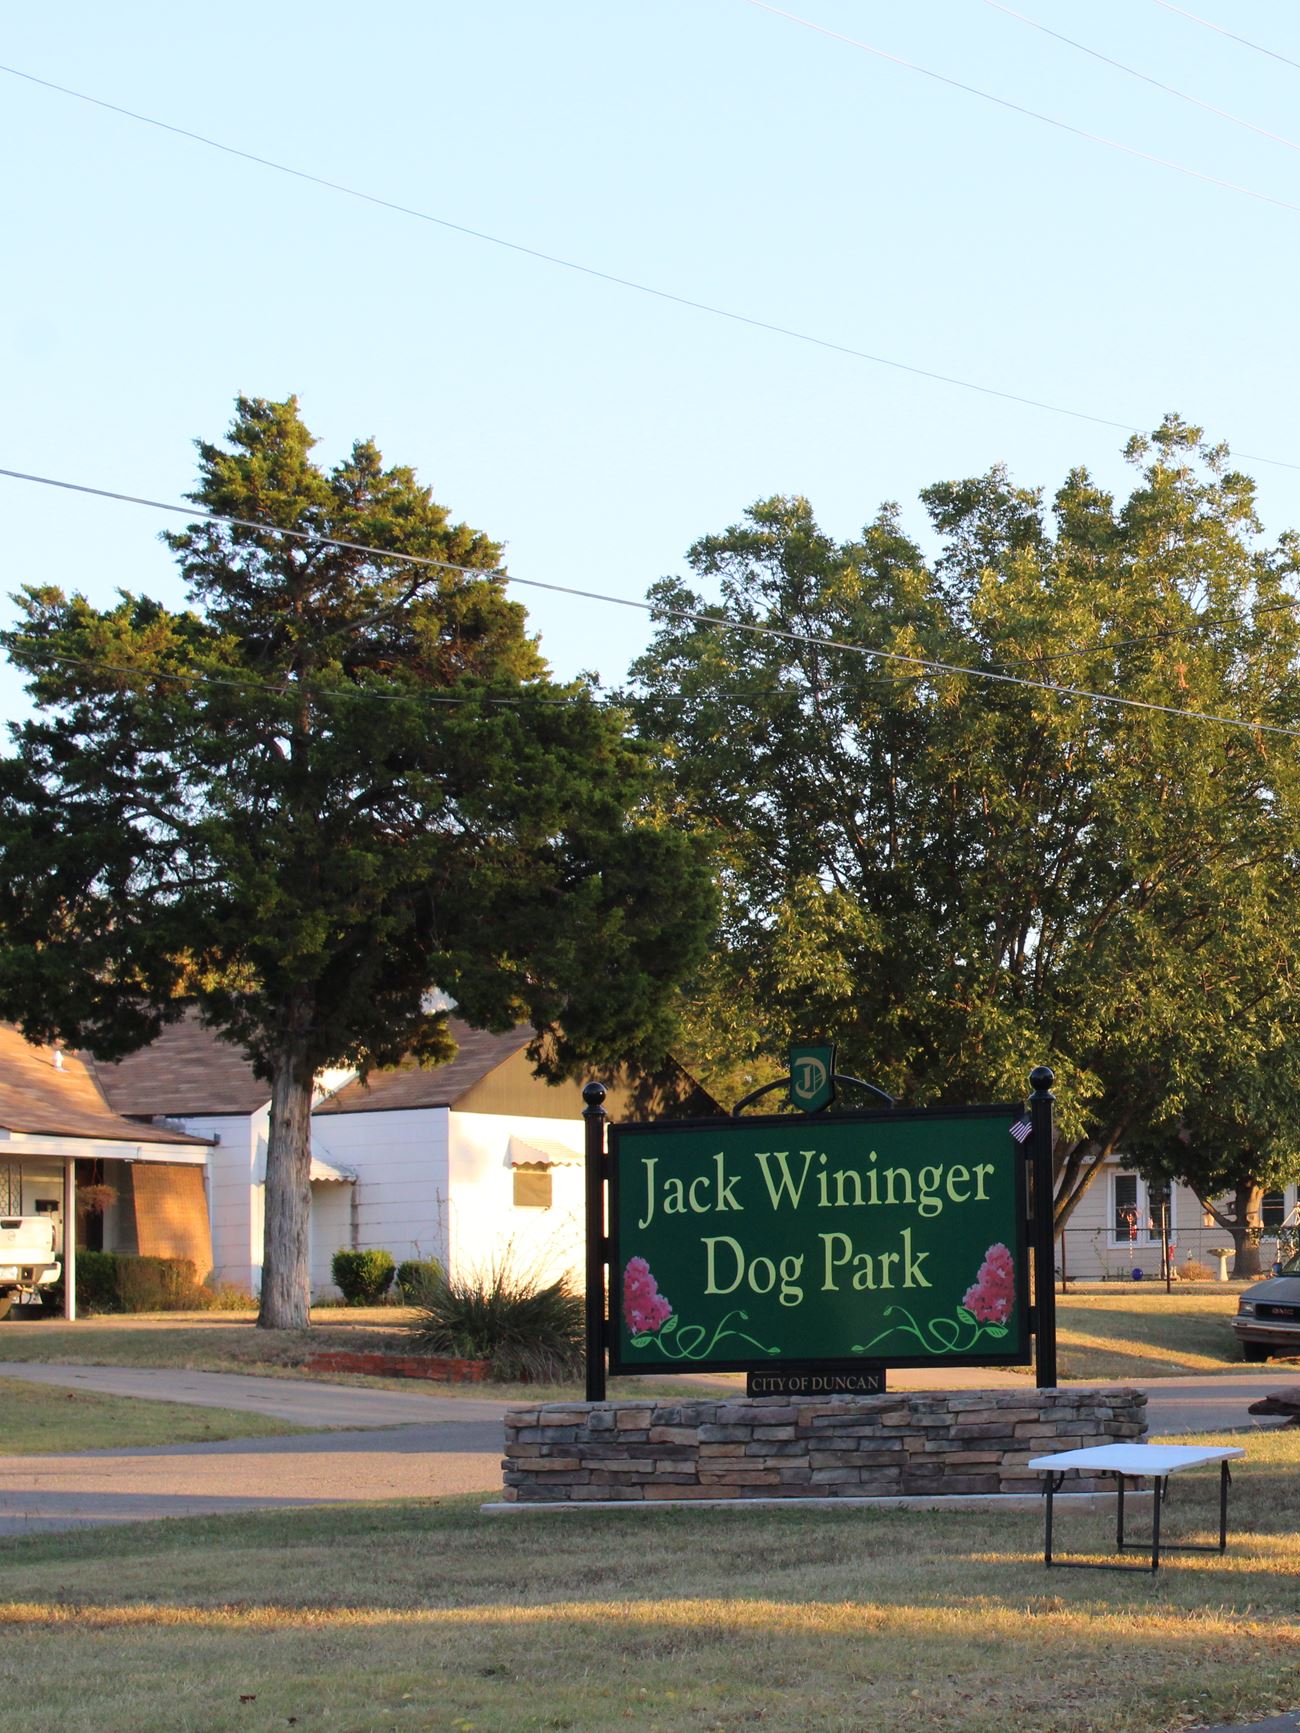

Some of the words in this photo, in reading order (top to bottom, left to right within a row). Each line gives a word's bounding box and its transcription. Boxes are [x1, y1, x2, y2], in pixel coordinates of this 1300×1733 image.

[638, 1151, 745, 1230] Jack
[754, 1150, 995, 1218] Wininger
[700, 1235, 804, 1307] Dog
[818, 1227, 932, 1292] Park
[1271, 1308, 1294, 1316] GMC
[752, 1377, 785, 1391] CITY
[788, 1376, 808, 1390] OF
[812, 1375, 879, 1390] DUNCAN
